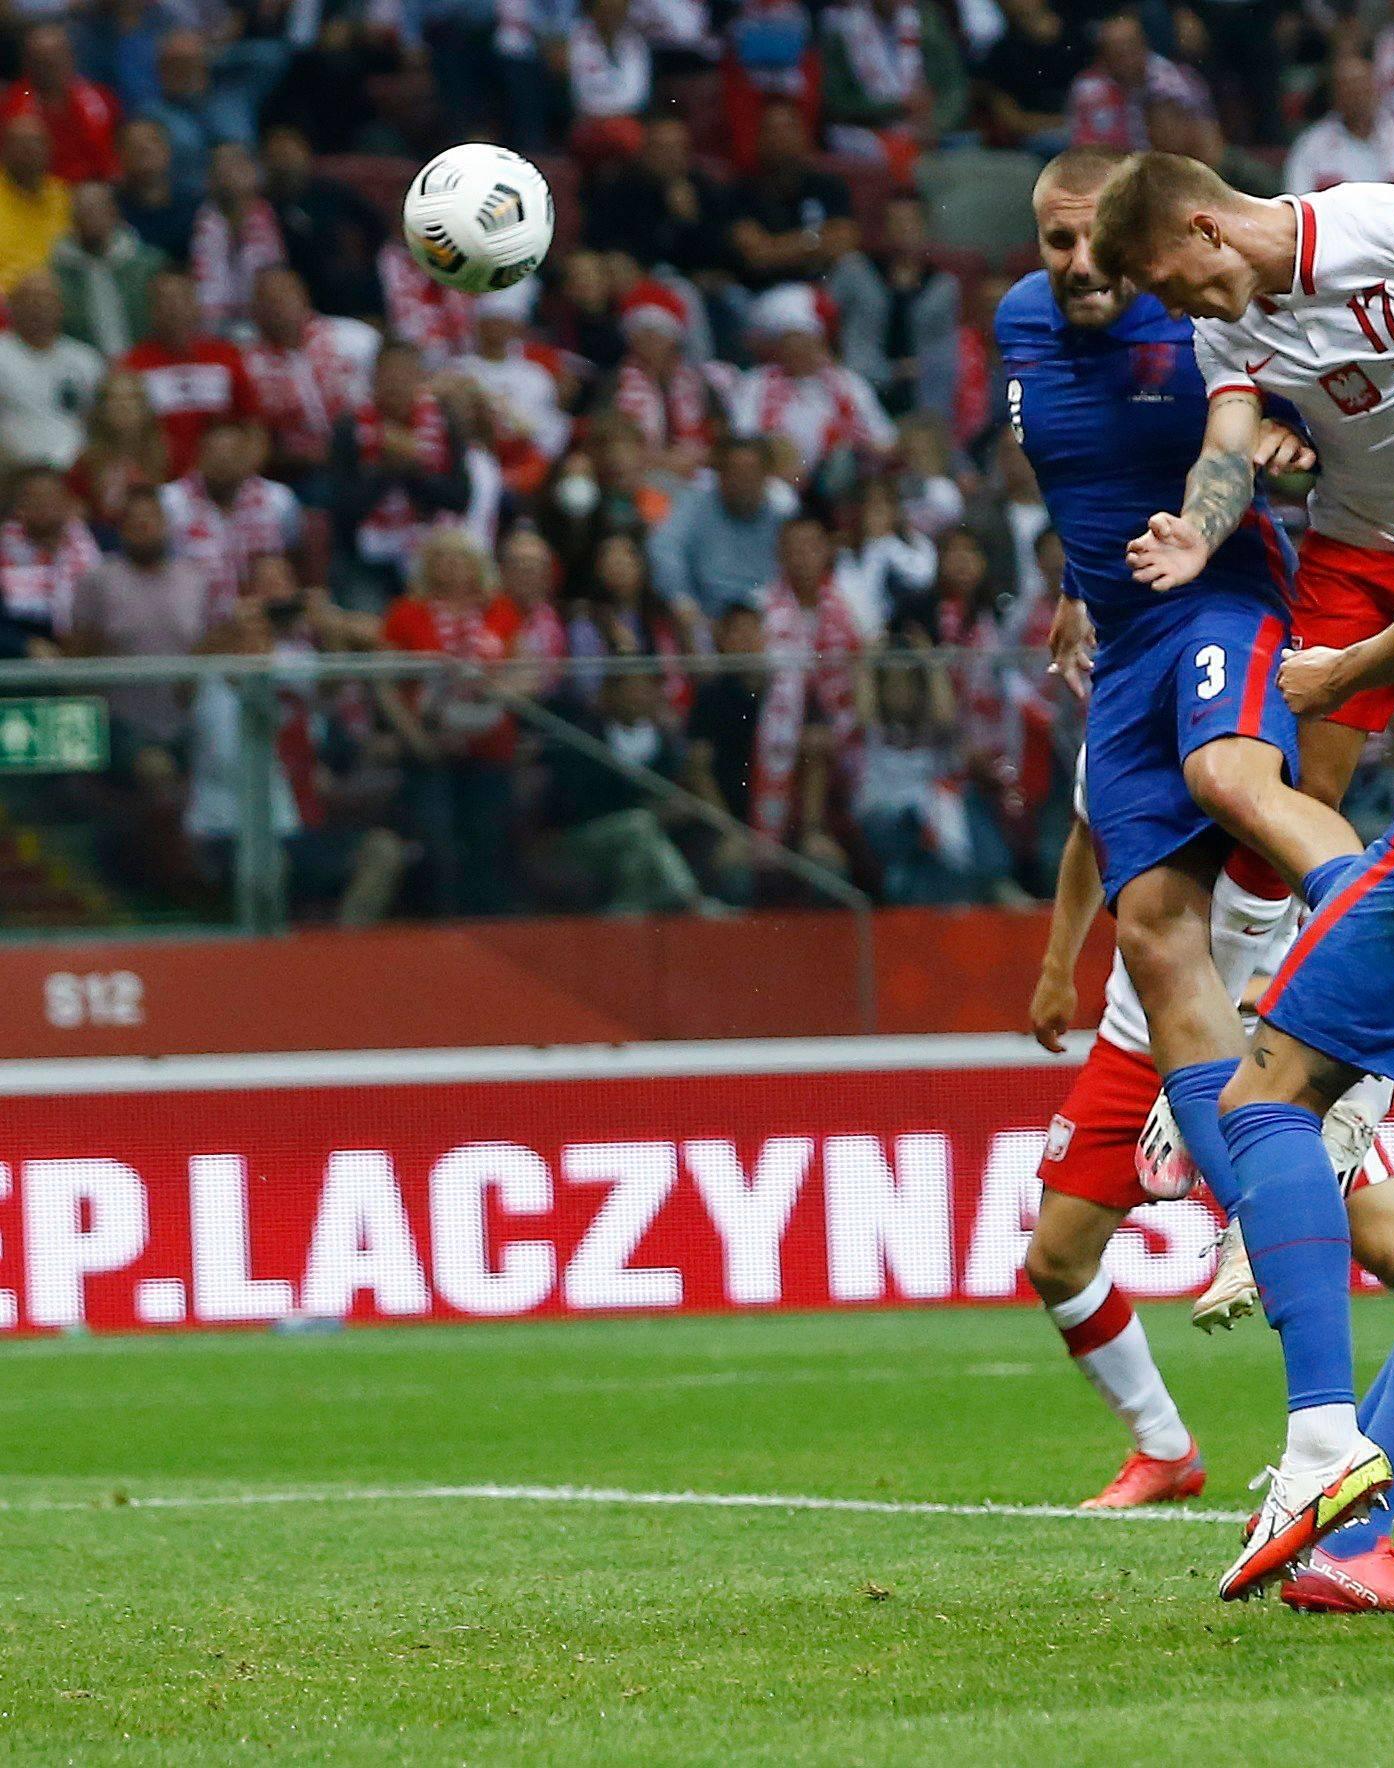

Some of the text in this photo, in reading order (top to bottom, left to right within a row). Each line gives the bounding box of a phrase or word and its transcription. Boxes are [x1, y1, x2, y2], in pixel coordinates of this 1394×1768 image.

[1195, 644, 1227, 700] 3
[45, 970, 144, 1028] S12
[1309, 1558, 1379, 1606] ULTRA
